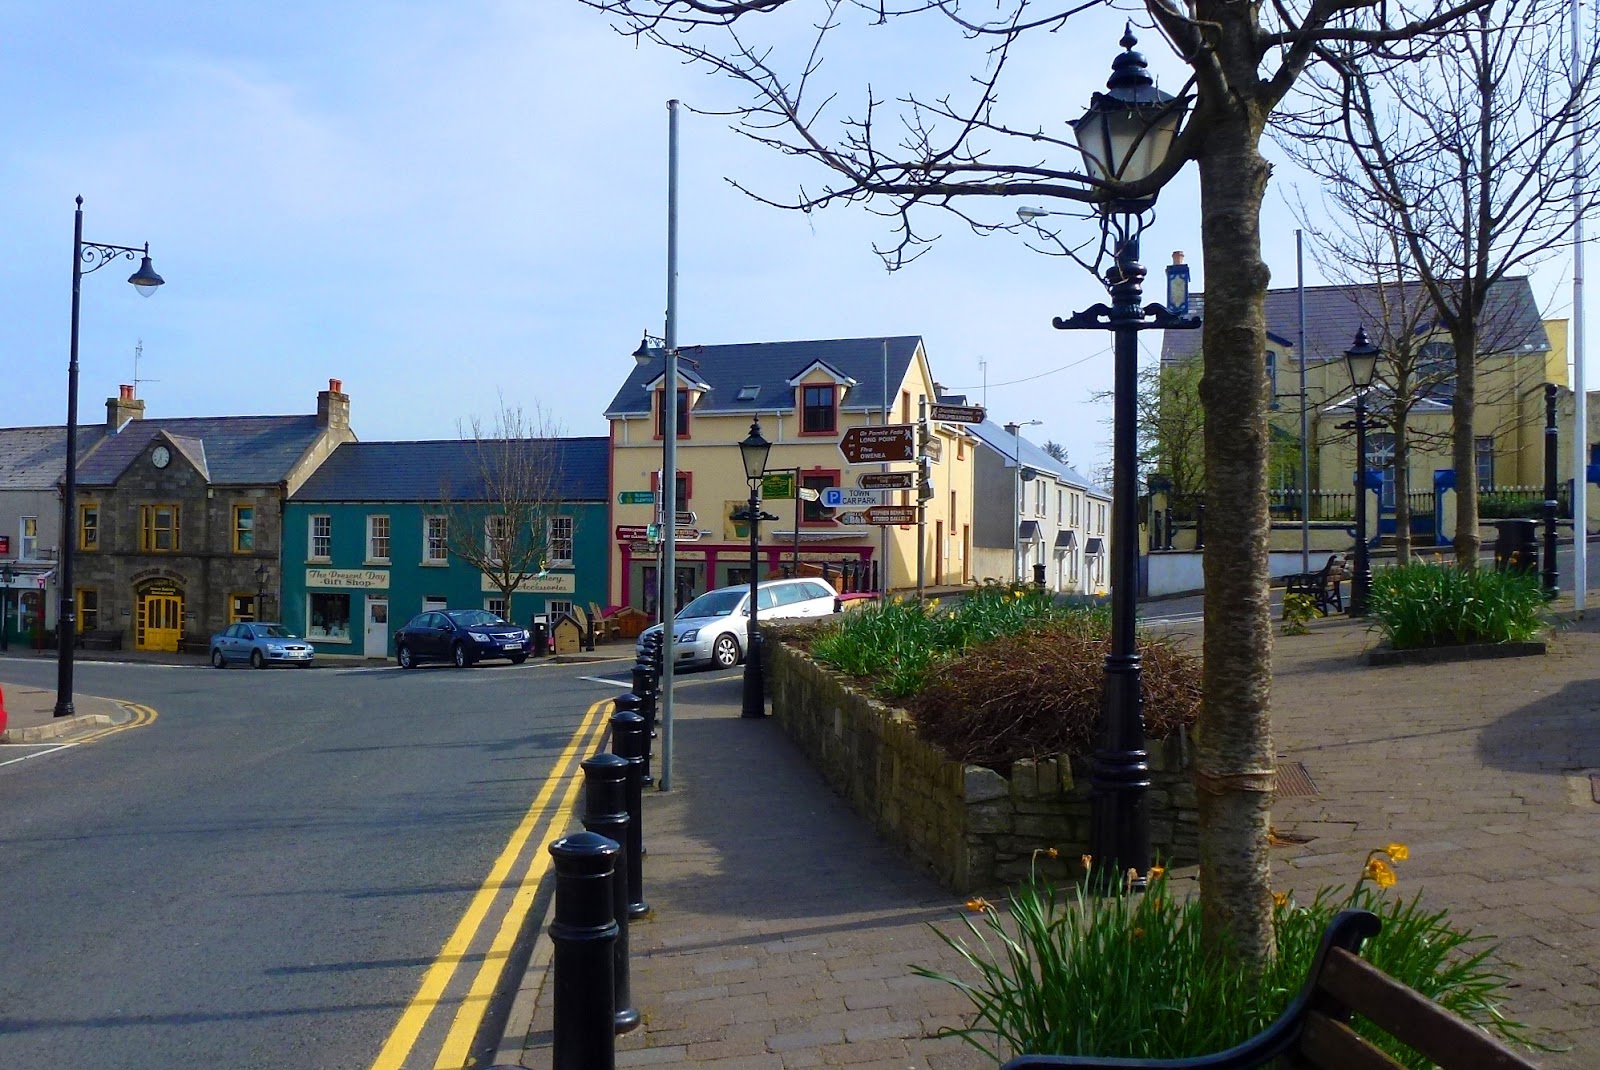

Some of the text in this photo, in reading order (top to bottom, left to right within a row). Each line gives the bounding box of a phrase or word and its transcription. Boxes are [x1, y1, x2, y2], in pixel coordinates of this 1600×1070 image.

[829, 491, 839, 502] P
[309, 570, 387, 583] The Present Day
[517, 583, 567, 591] Accessories
